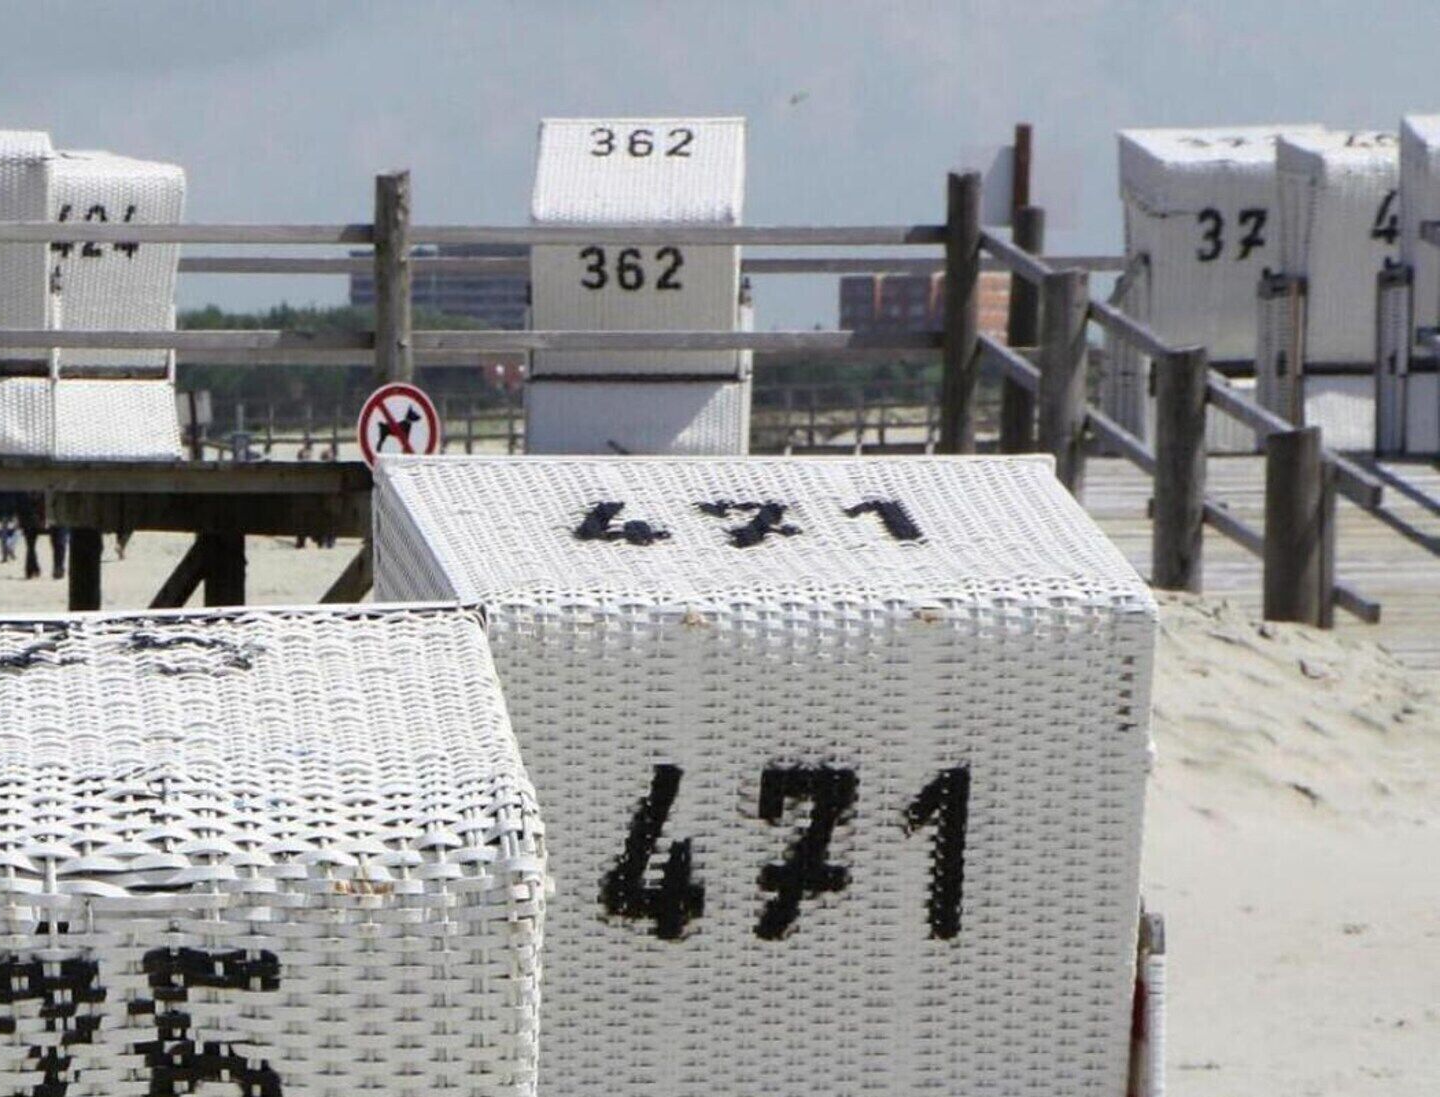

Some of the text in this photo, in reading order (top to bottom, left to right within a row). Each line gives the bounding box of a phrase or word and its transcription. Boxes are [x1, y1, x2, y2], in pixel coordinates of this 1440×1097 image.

[591, 127, 694, 157] 362
[579, 246, 685, 291] 362
[597, 761, 972, 941] 471
